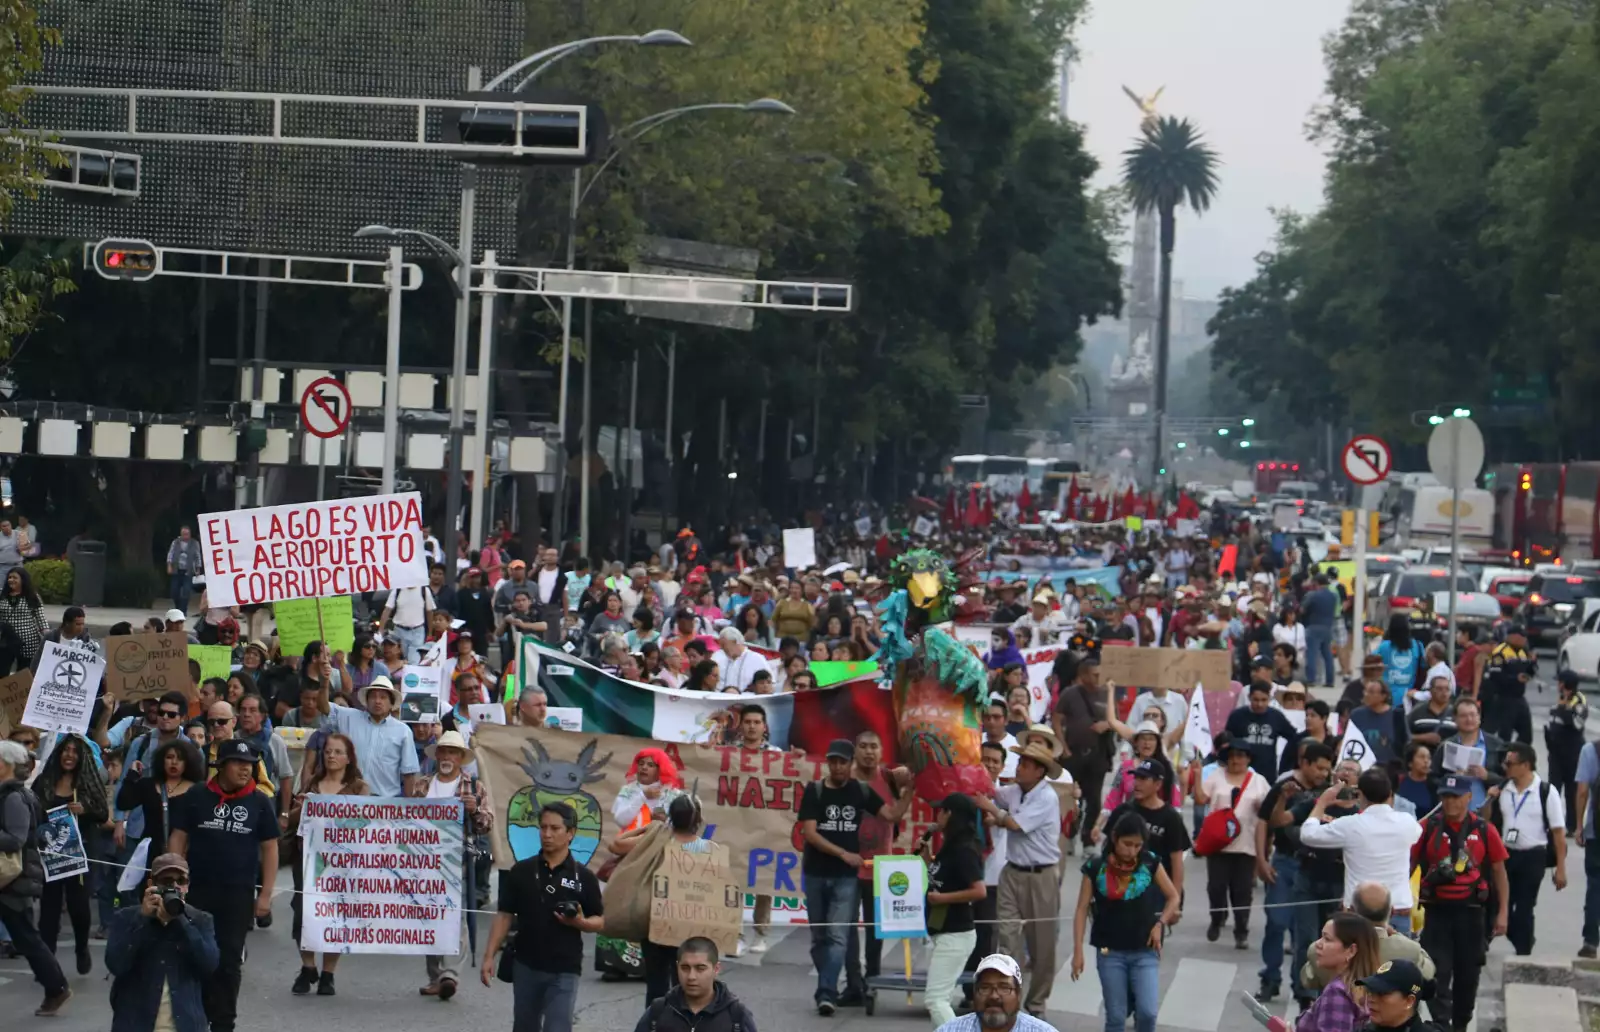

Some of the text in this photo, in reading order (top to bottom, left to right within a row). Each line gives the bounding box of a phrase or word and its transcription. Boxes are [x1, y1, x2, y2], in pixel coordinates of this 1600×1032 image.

[208, 498, 423, 545] EL LAGO ES VIDA
[213, 533, 414, 574] EL AEROPUERTO
[233, 564, 390, 604] CORRUPCION
[158, 639, 172, 649] YO
[52, 647, 96, 664] MARCHA
[123, 675, 167, 691] LAGO
[57, 706, 84, 716] octubre
[307, 802, 458, 820] BIOLOGOS: CONTRA ECOCIDIOS
[324, 828, 440, 844] FUERA PLAGA HUMANA
[322, 852, 441, 870] Y CAPITALISMO SALVAJE
[670, 849, 725, 880] NO AL
[316, 877, 446, 894] FLORA Y FAUNA MEXICANA
[315, 902, 447, 920] SON PRIMERA PRIORIDAD Y
[324, 927, 435, 945] CULTURAS ORIGINALES
